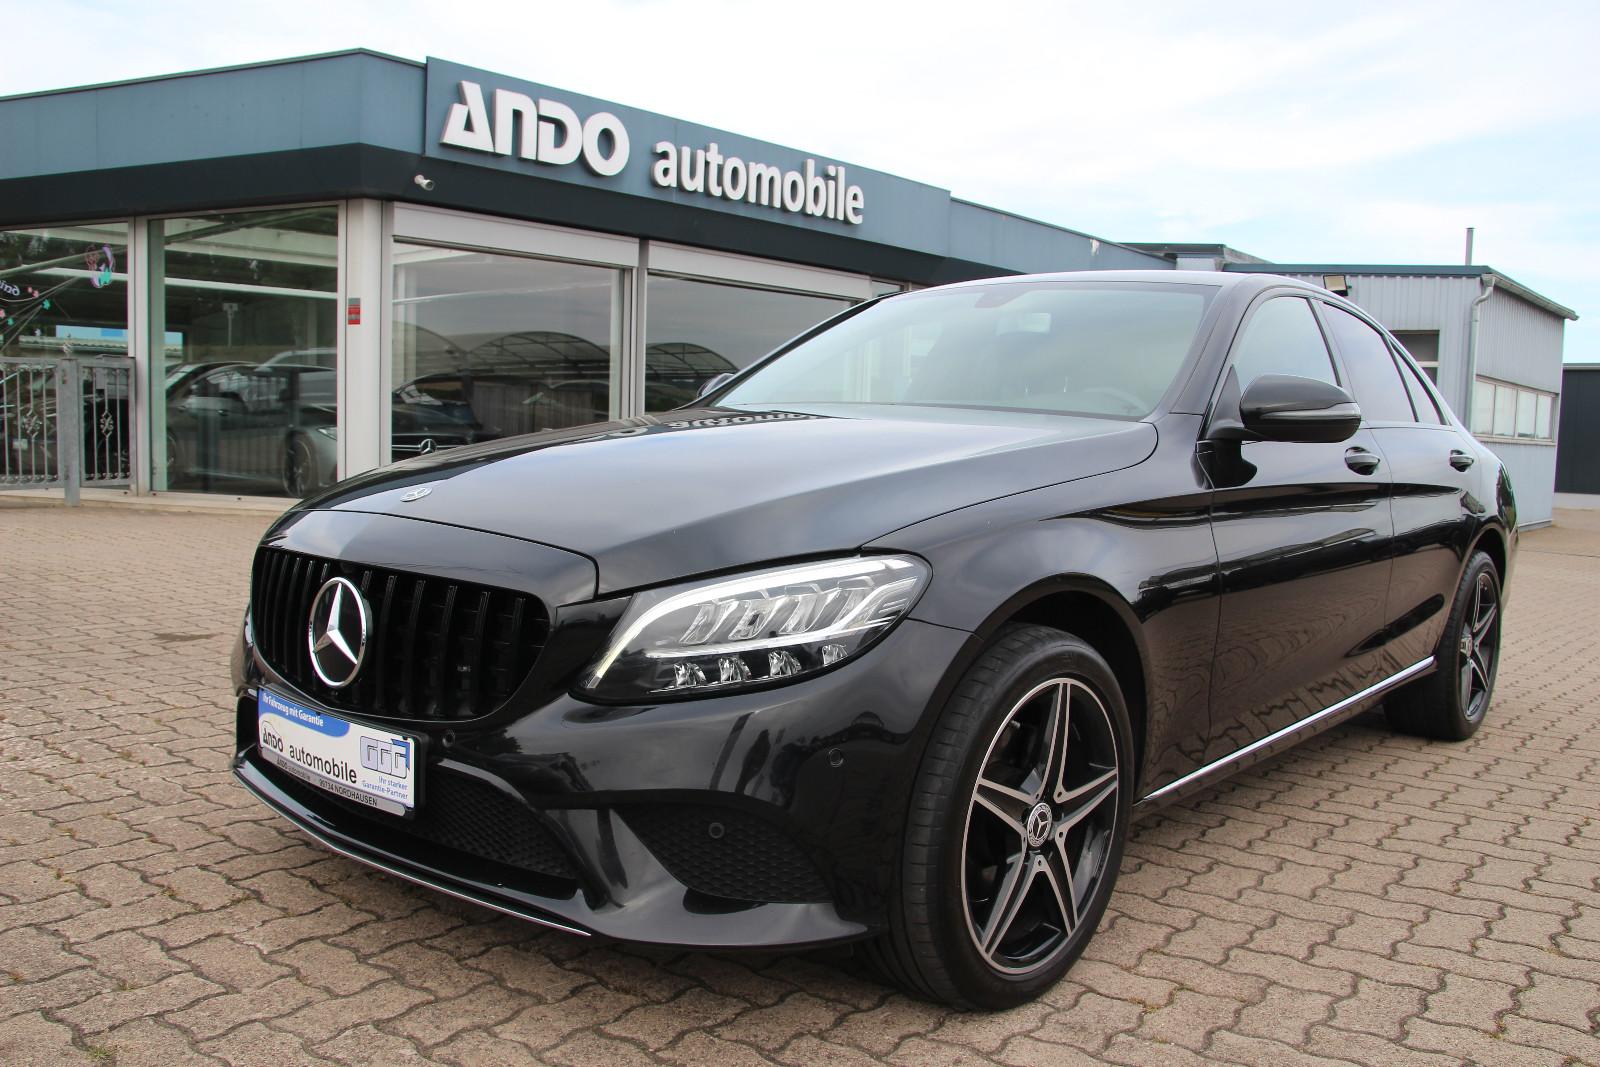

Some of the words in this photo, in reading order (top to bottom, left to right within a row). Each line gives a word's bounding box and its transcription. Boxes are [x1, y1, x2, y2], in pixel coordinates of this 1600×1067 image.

[440, 80, 630, 177] ANDO
[650, 140, 865, 225] automobile
[269, 695, 289, 716] Fahrzeug
[289, 706, 299, 718] mit
[299, 709, 324, 727] Garantie
[262, 727, 284, 753] ANDO
[289, 744, 357, 784] automobile
[334, 783, 378, 807] NORDHAUSEN
[361, 780, 408, 800] Garantie-Partner
[387, 779, 408, 790] starker
